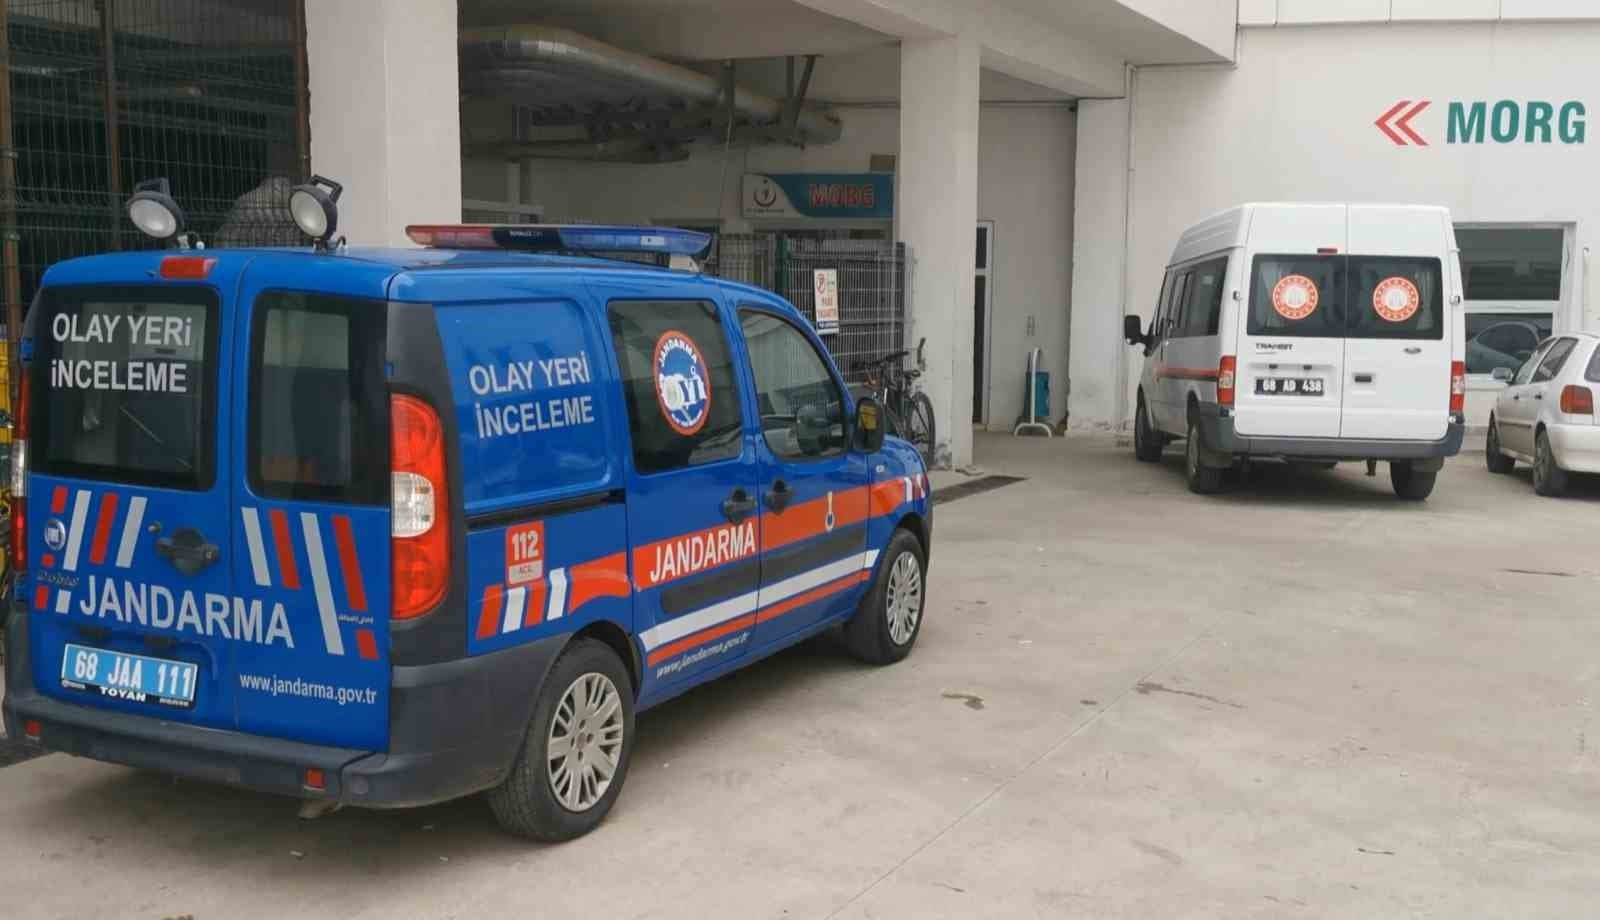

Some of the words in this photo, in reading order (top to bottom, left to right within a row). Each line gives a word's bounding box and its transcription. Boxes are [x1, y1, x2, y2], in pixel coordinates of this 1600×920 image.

[1447, 99, 1586, 144] MORG
[52, 312, 121, 343] OLAY
[469, 360, 534, 395] OLAY
[1263, 378, 1277, 392] 68
[1283, 379, 1297, 392] AD
[511, 530, 539, 561] 112
[650, 521, 757, 583] JANDARMA
[79, 574, 296, 649] JANDARMA
[74, 650, 99, 681] 68
[107, 656, 143, 690] JAA
[157, 663, 193, 698] 111
[239, 673, 378, 705] www.jandarma.gov.tr
